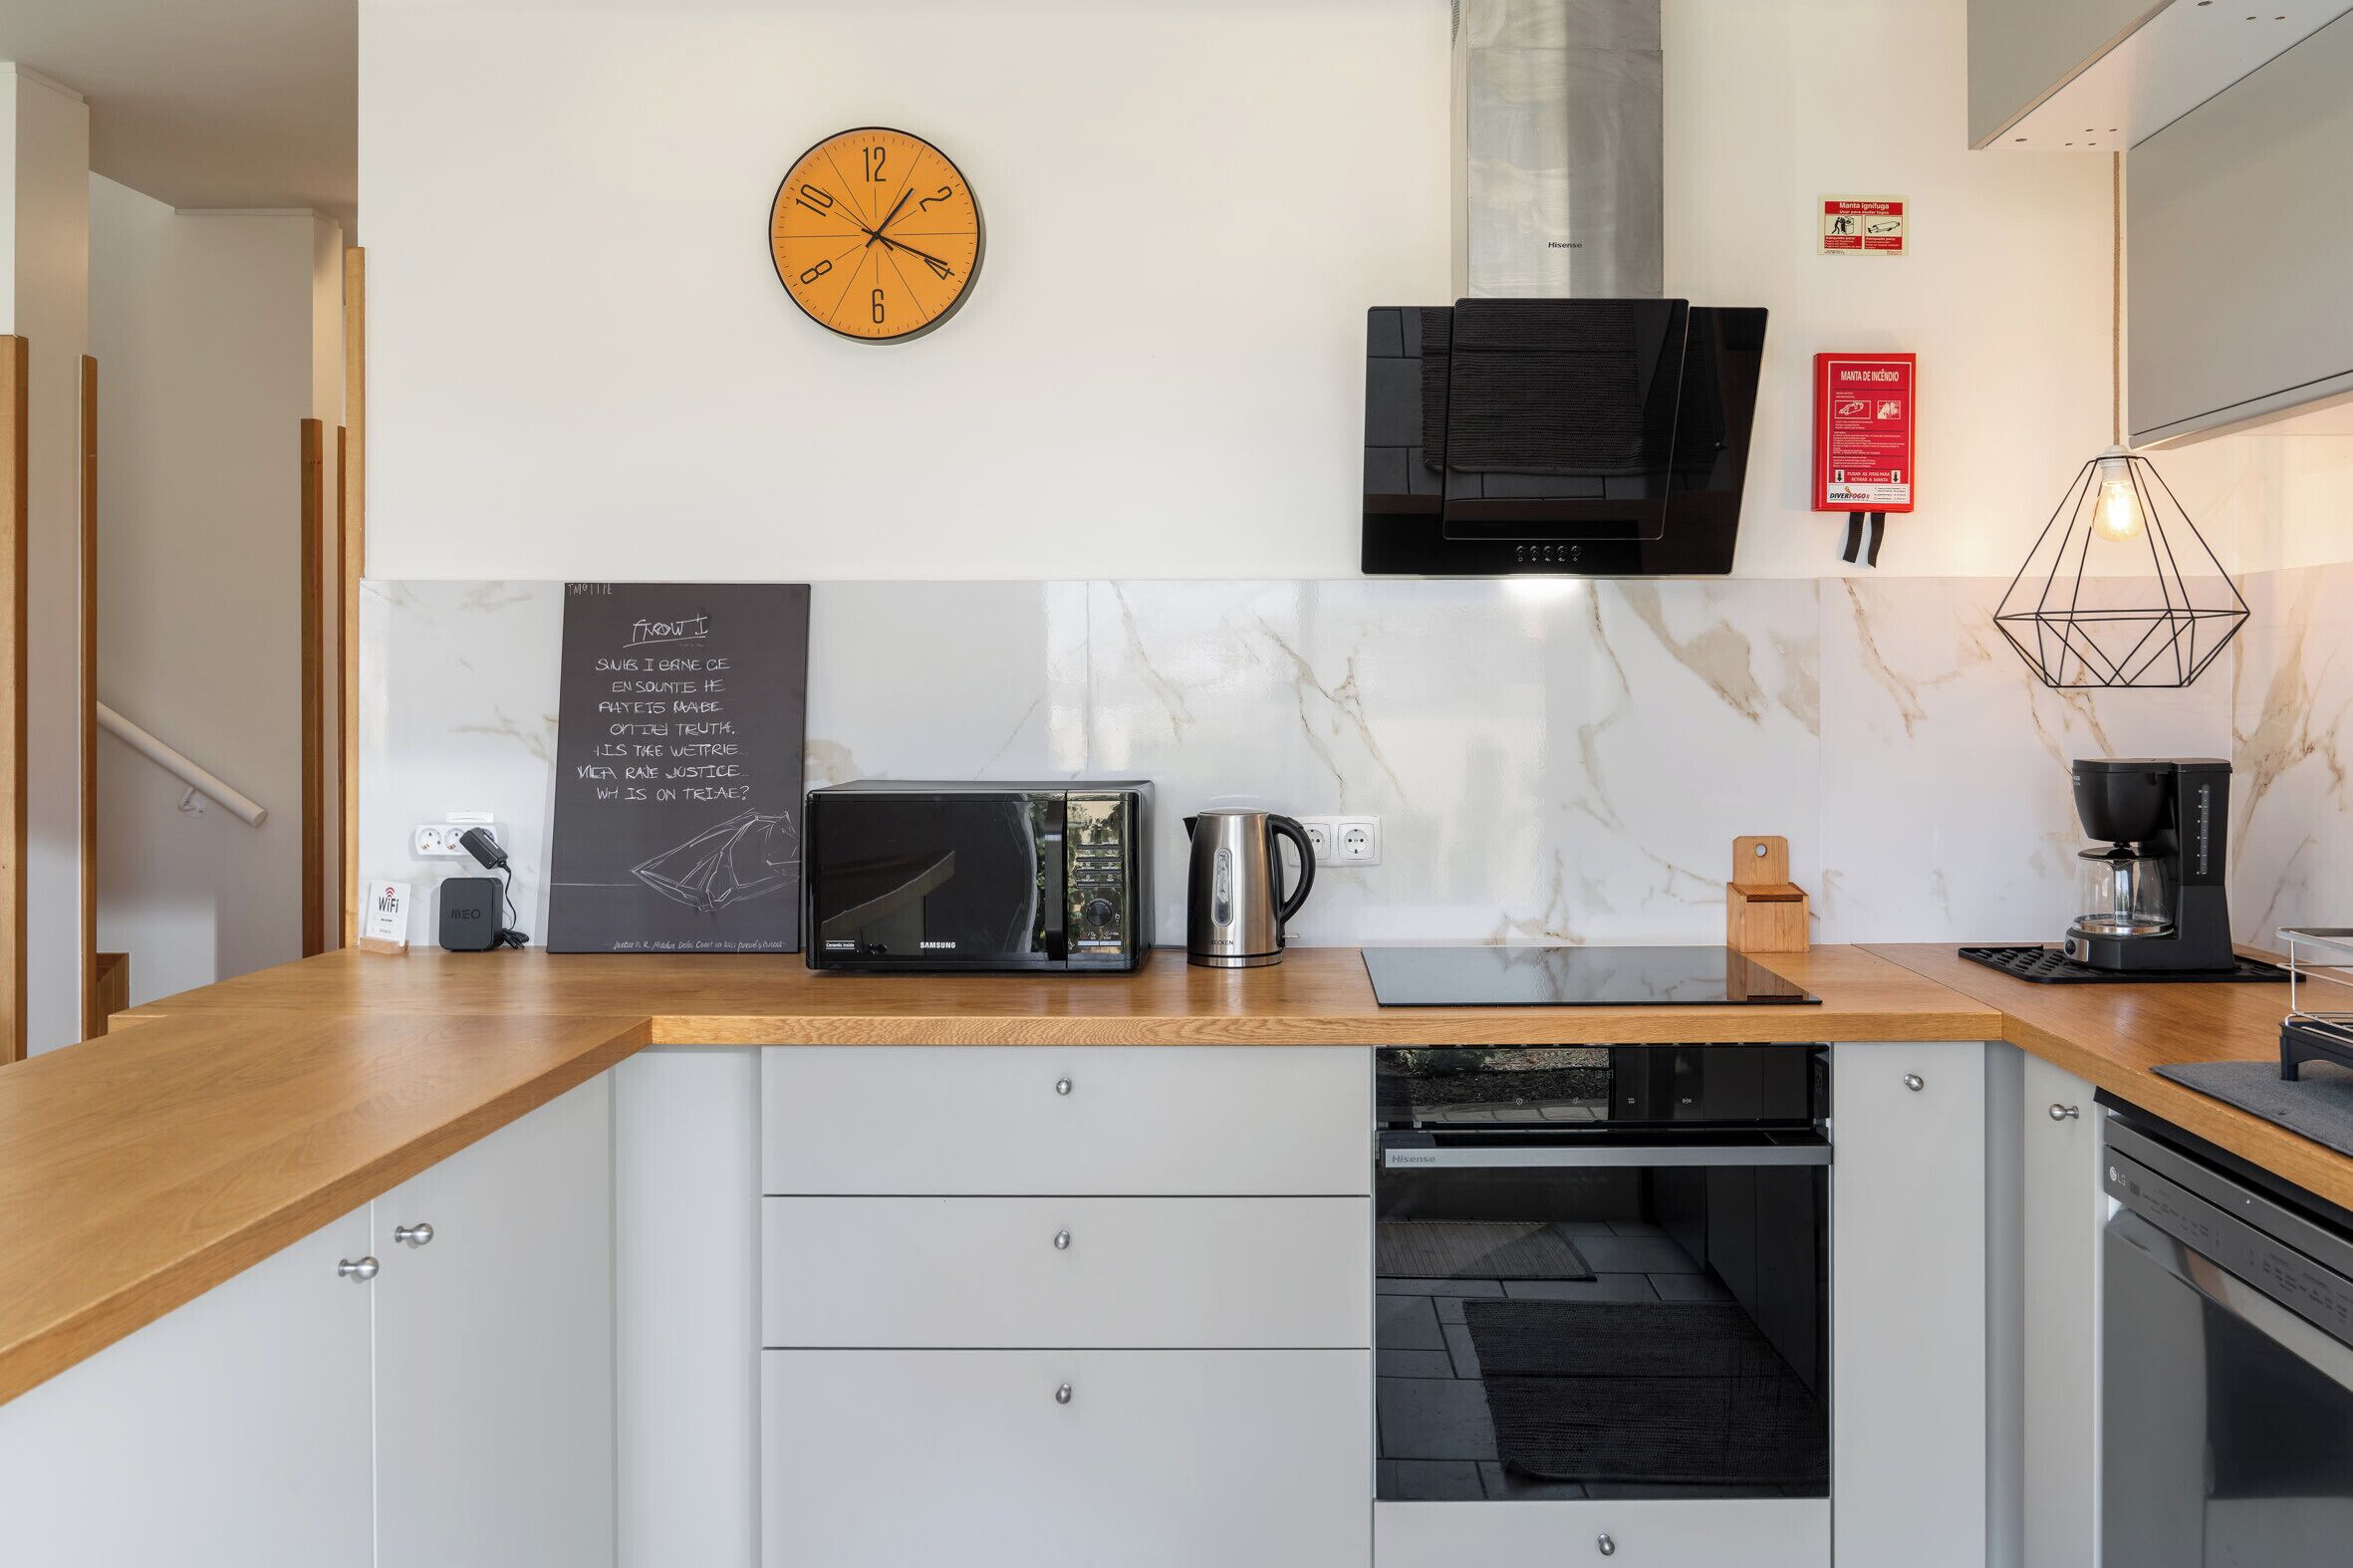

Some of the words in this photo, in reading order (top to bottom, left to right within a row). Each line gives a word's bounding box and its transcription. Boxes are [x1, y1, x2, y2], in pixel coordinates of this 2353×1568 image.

[863, 146, 887, 182] 12
[795, 183, 834, 217] 10
[917, 185, 952, 213] 2
[800, 259, 833, 285] 8
[922, 257, 955, 281] 4
[1840, 371, 1863, 382] MANTA
[1862, 372, 1871, 382] DE
[1871, 368, 1900, 383] INCÊNDIO
[625, 787, 648, 801] IS
[656, 788, 676, 802] ON
[379, 896, 399, 914] WiFi
[1392, 1155, 1437, 1164] Hisense
